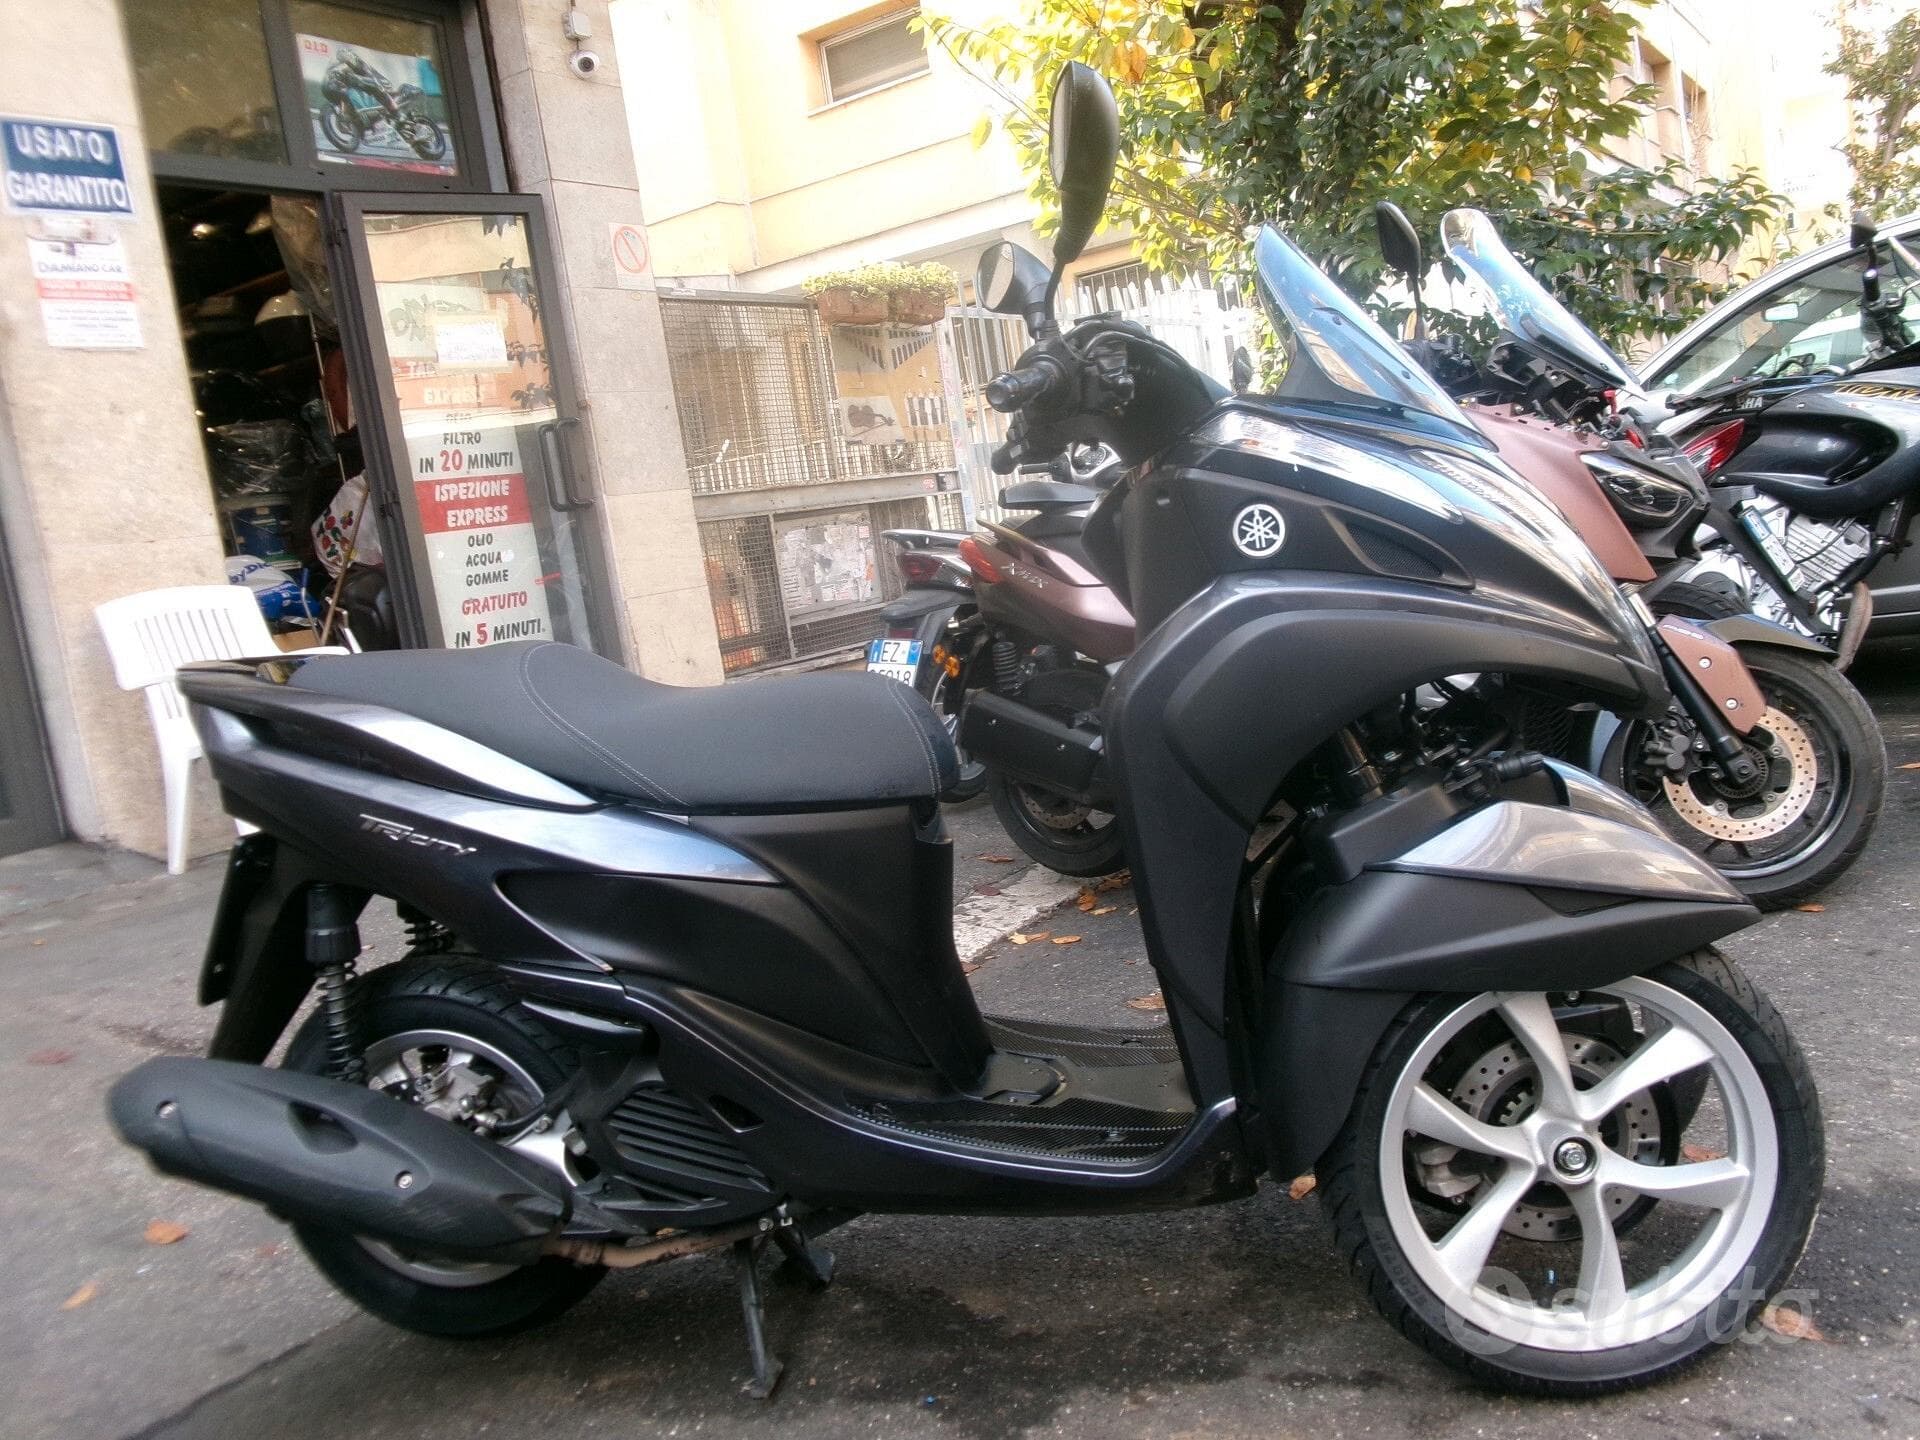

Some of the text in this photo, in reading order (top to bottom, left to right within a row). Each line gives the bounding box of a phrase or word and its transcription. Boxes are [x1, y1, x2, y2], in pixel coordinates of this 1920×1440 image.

[12, 124, 112, 164] USATO
[8, 170, 127, 207] GARANTITO
[443, 432, 482, 445] FILTRO
[419, 449, 513, 474] IN 20 MINUTI
[434, 480, 510, 502] ISPEZIONE
[447, 505, 508, 528] EXPRESS
[467, 533, 494, 548] OLIO
[466, 552, 503, 567] ACQUA
[466, 569, 509, 586] GOMME
[462, 591, 528, 616] GRATUITO
[455, 631, 471, 648] IN
[476, 623, 488, 645] 5
[881, 642, 901, 662] EZ
